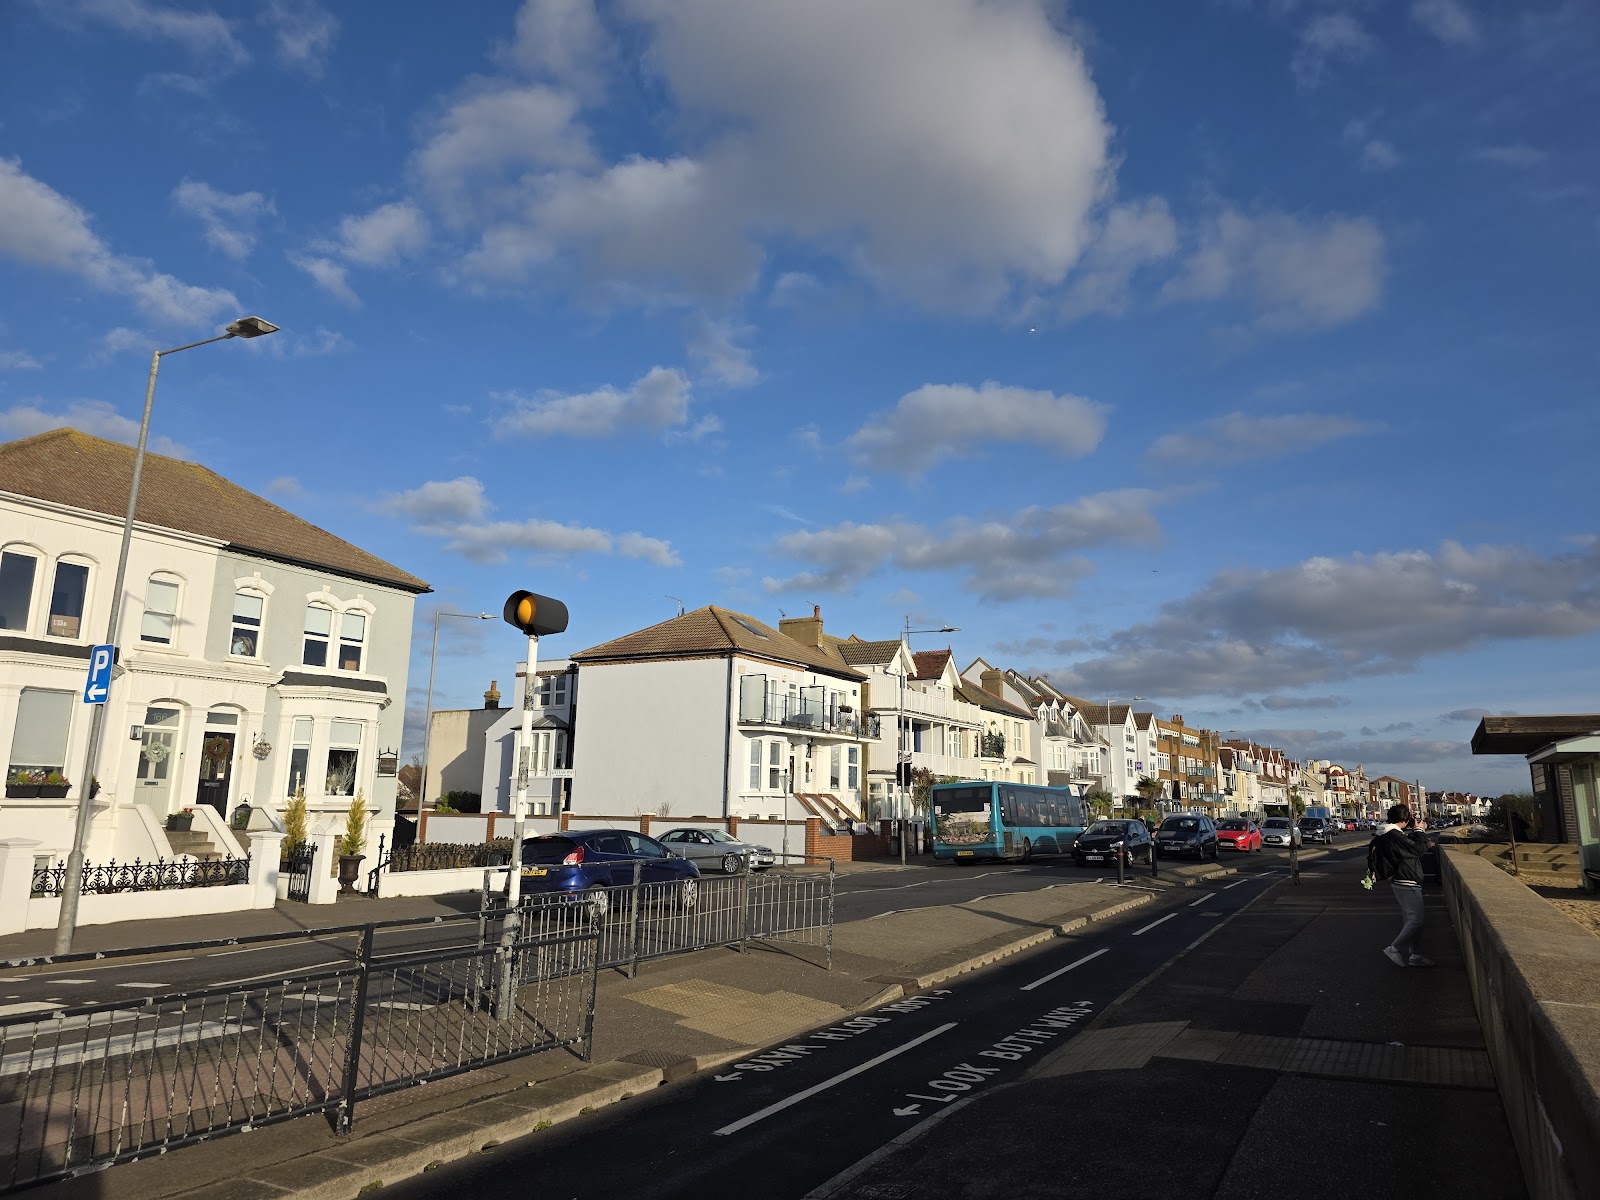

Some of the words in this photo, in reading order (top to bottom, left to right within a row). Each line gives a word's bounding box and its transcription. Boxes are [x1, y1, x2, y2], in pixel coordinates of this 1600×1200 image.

[91, 650, 110, 682] P
[152, 712, 168, 721] 166
[810, 1016, 892, 1041] BOTH
[734, 1044, 827, 1072] WAYS
[905, 1062, 1001, 1102] LOOK
[978, 1028, 1058, 1061] BOTH
[1030, 1006, 1093, 1028] WAYS
